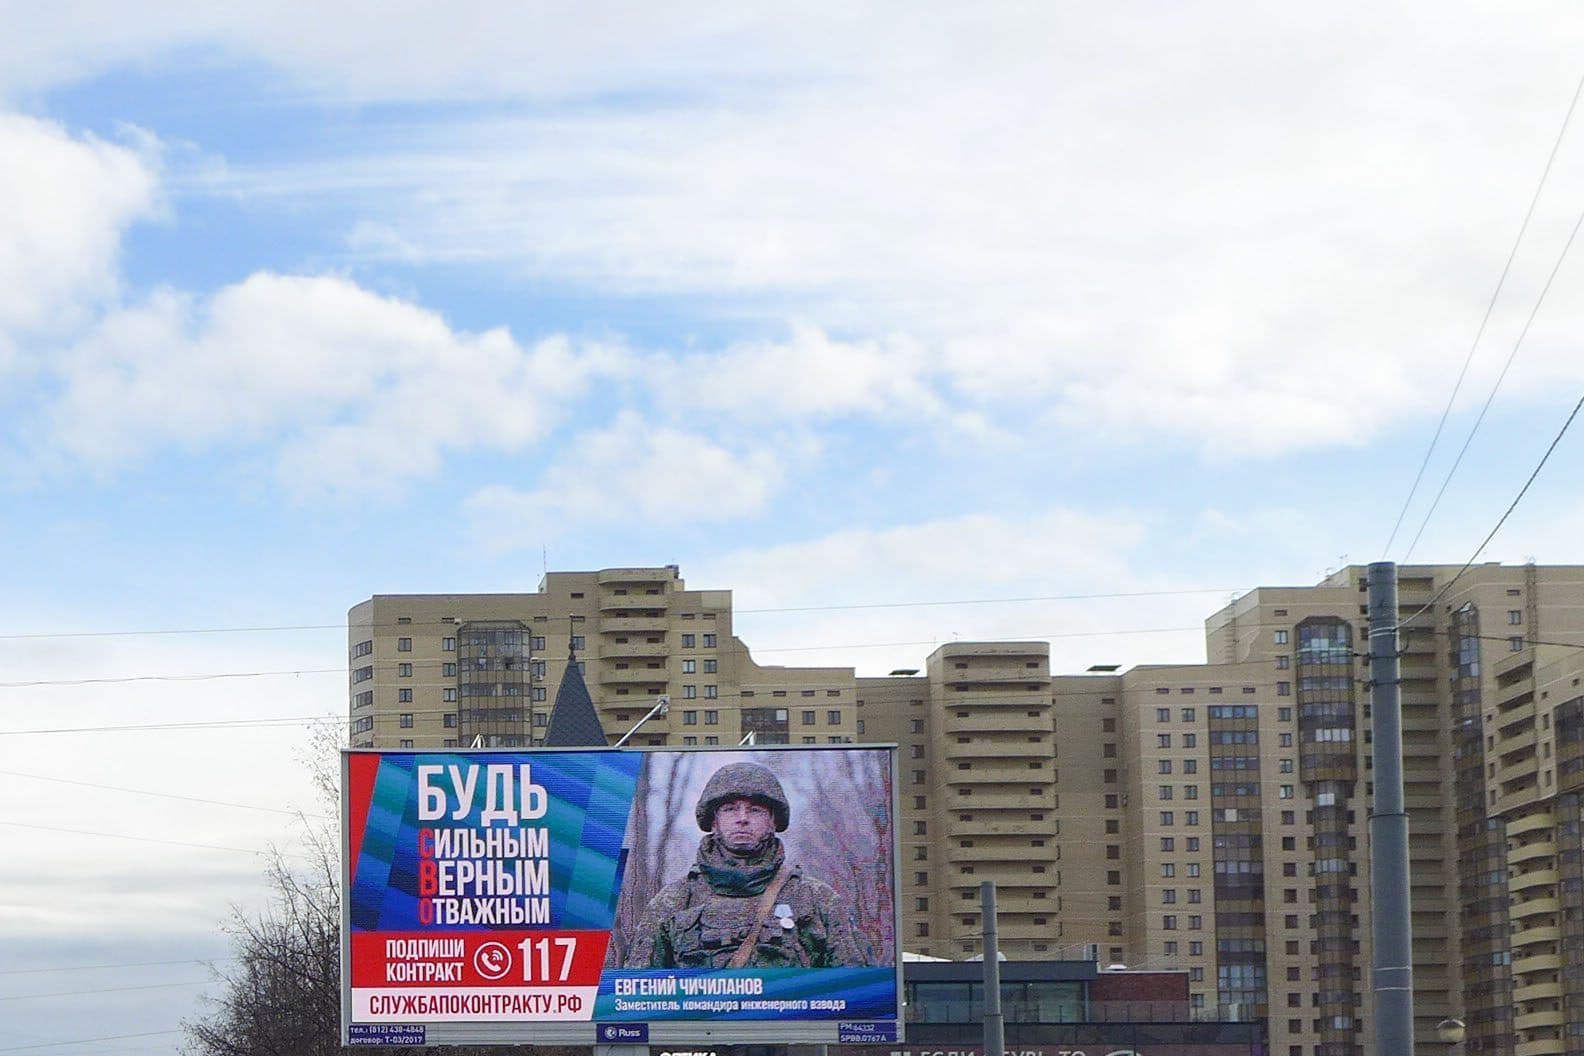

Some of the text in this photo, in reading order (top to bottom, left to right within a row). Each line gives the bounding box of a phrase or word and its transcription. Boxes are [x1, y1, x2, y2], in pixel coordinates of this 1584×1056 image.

[418, 764, 548, 827] БУДЬ
[418, 827, 549, 859] СИЛЬНЫМ
[419, 860, 549, 896] ВЕРНЫМ
[419, 898, 550, 926] ОТВАЖНЫМ
[385, 939, 465, 960] ПОДПИШИ
[517, 937, 577, 982] 117
[385, 962, 465, 982] КОНТРАКТ
[614, 975, 677, 995] ЕВГЕНИЙ
[369, 994, 583, 1014] СЛУЖБАПОКОНТРАКТУ.РФ
[615, 998, 846, 1012] Заместитель командира инженерного взвода
[618, 1028, 641, 1037] Russ
